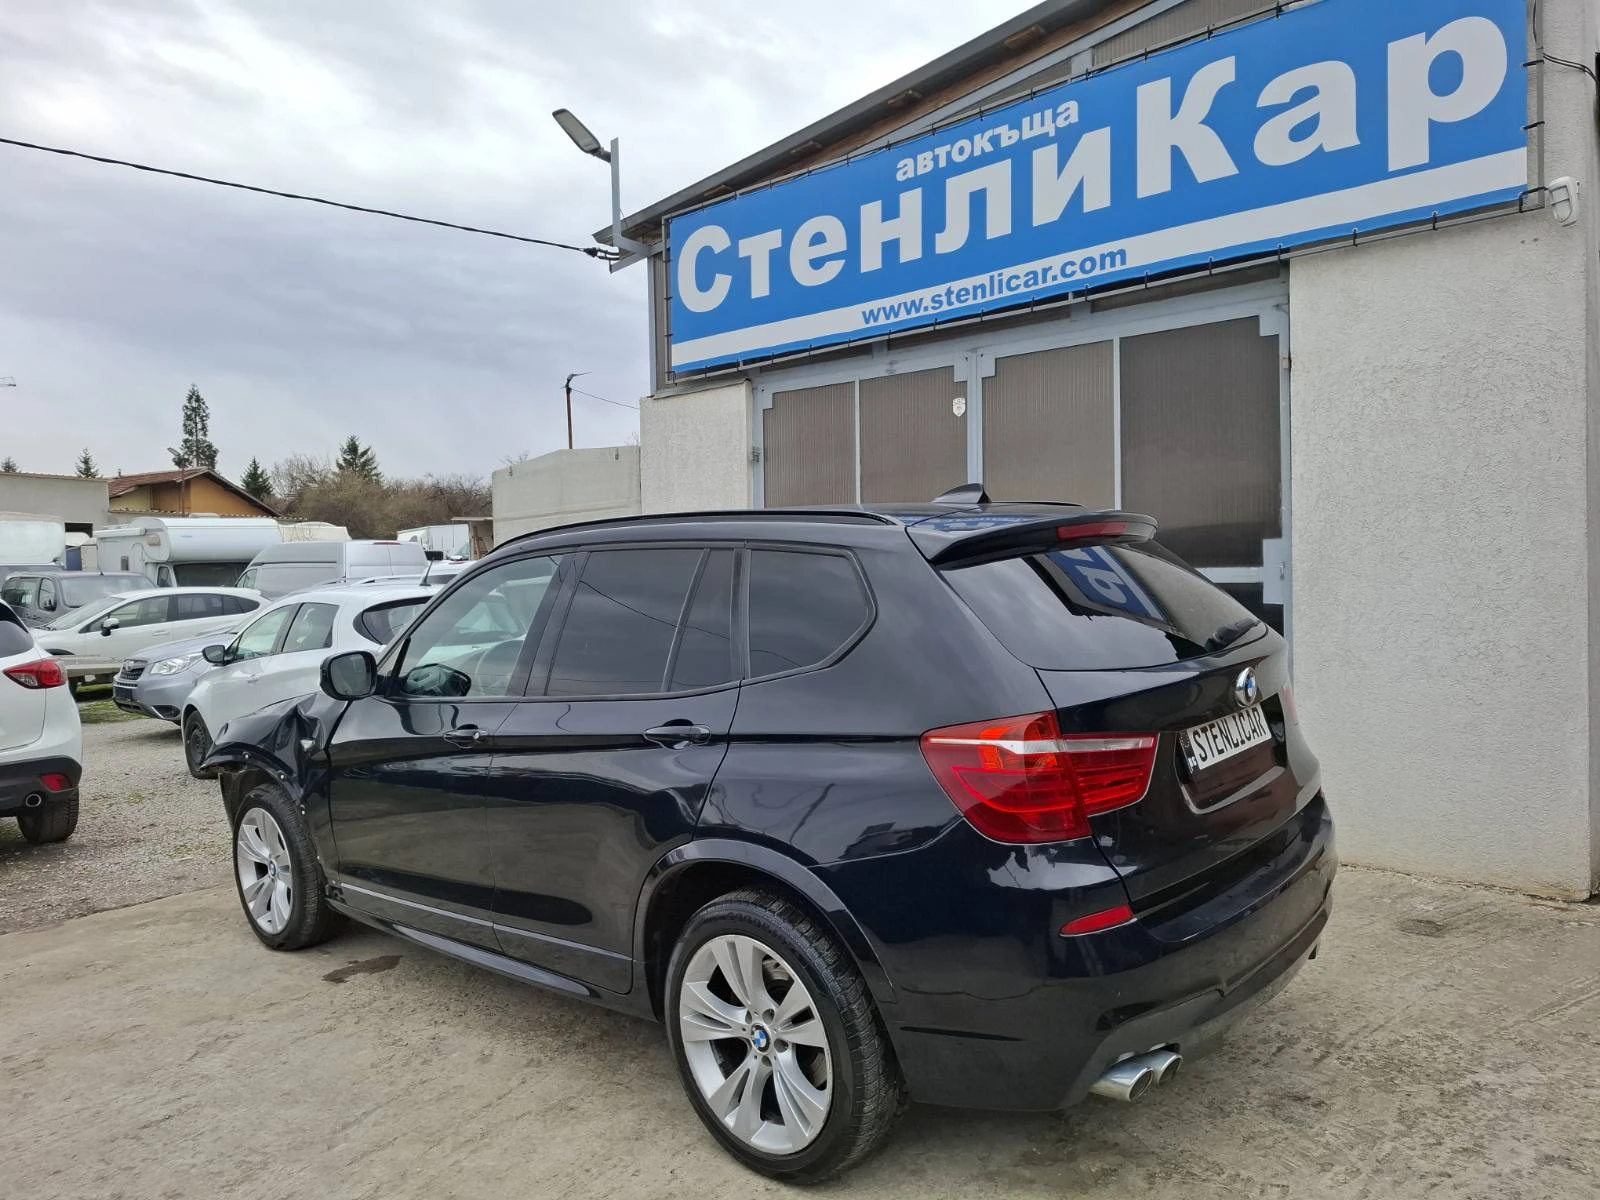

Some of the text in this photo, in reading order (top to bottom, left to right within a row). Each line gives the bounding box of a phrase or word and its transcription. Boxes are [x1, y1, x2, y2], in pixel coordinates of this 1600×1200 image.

[678, 16, 1509, 314] СтенлиКар
[896, 100, 1079, 181] автокъща
[862, 248, 1127, 325] www.stenlicar.com
[1192, 708, 1267, 762] STENLICAR
